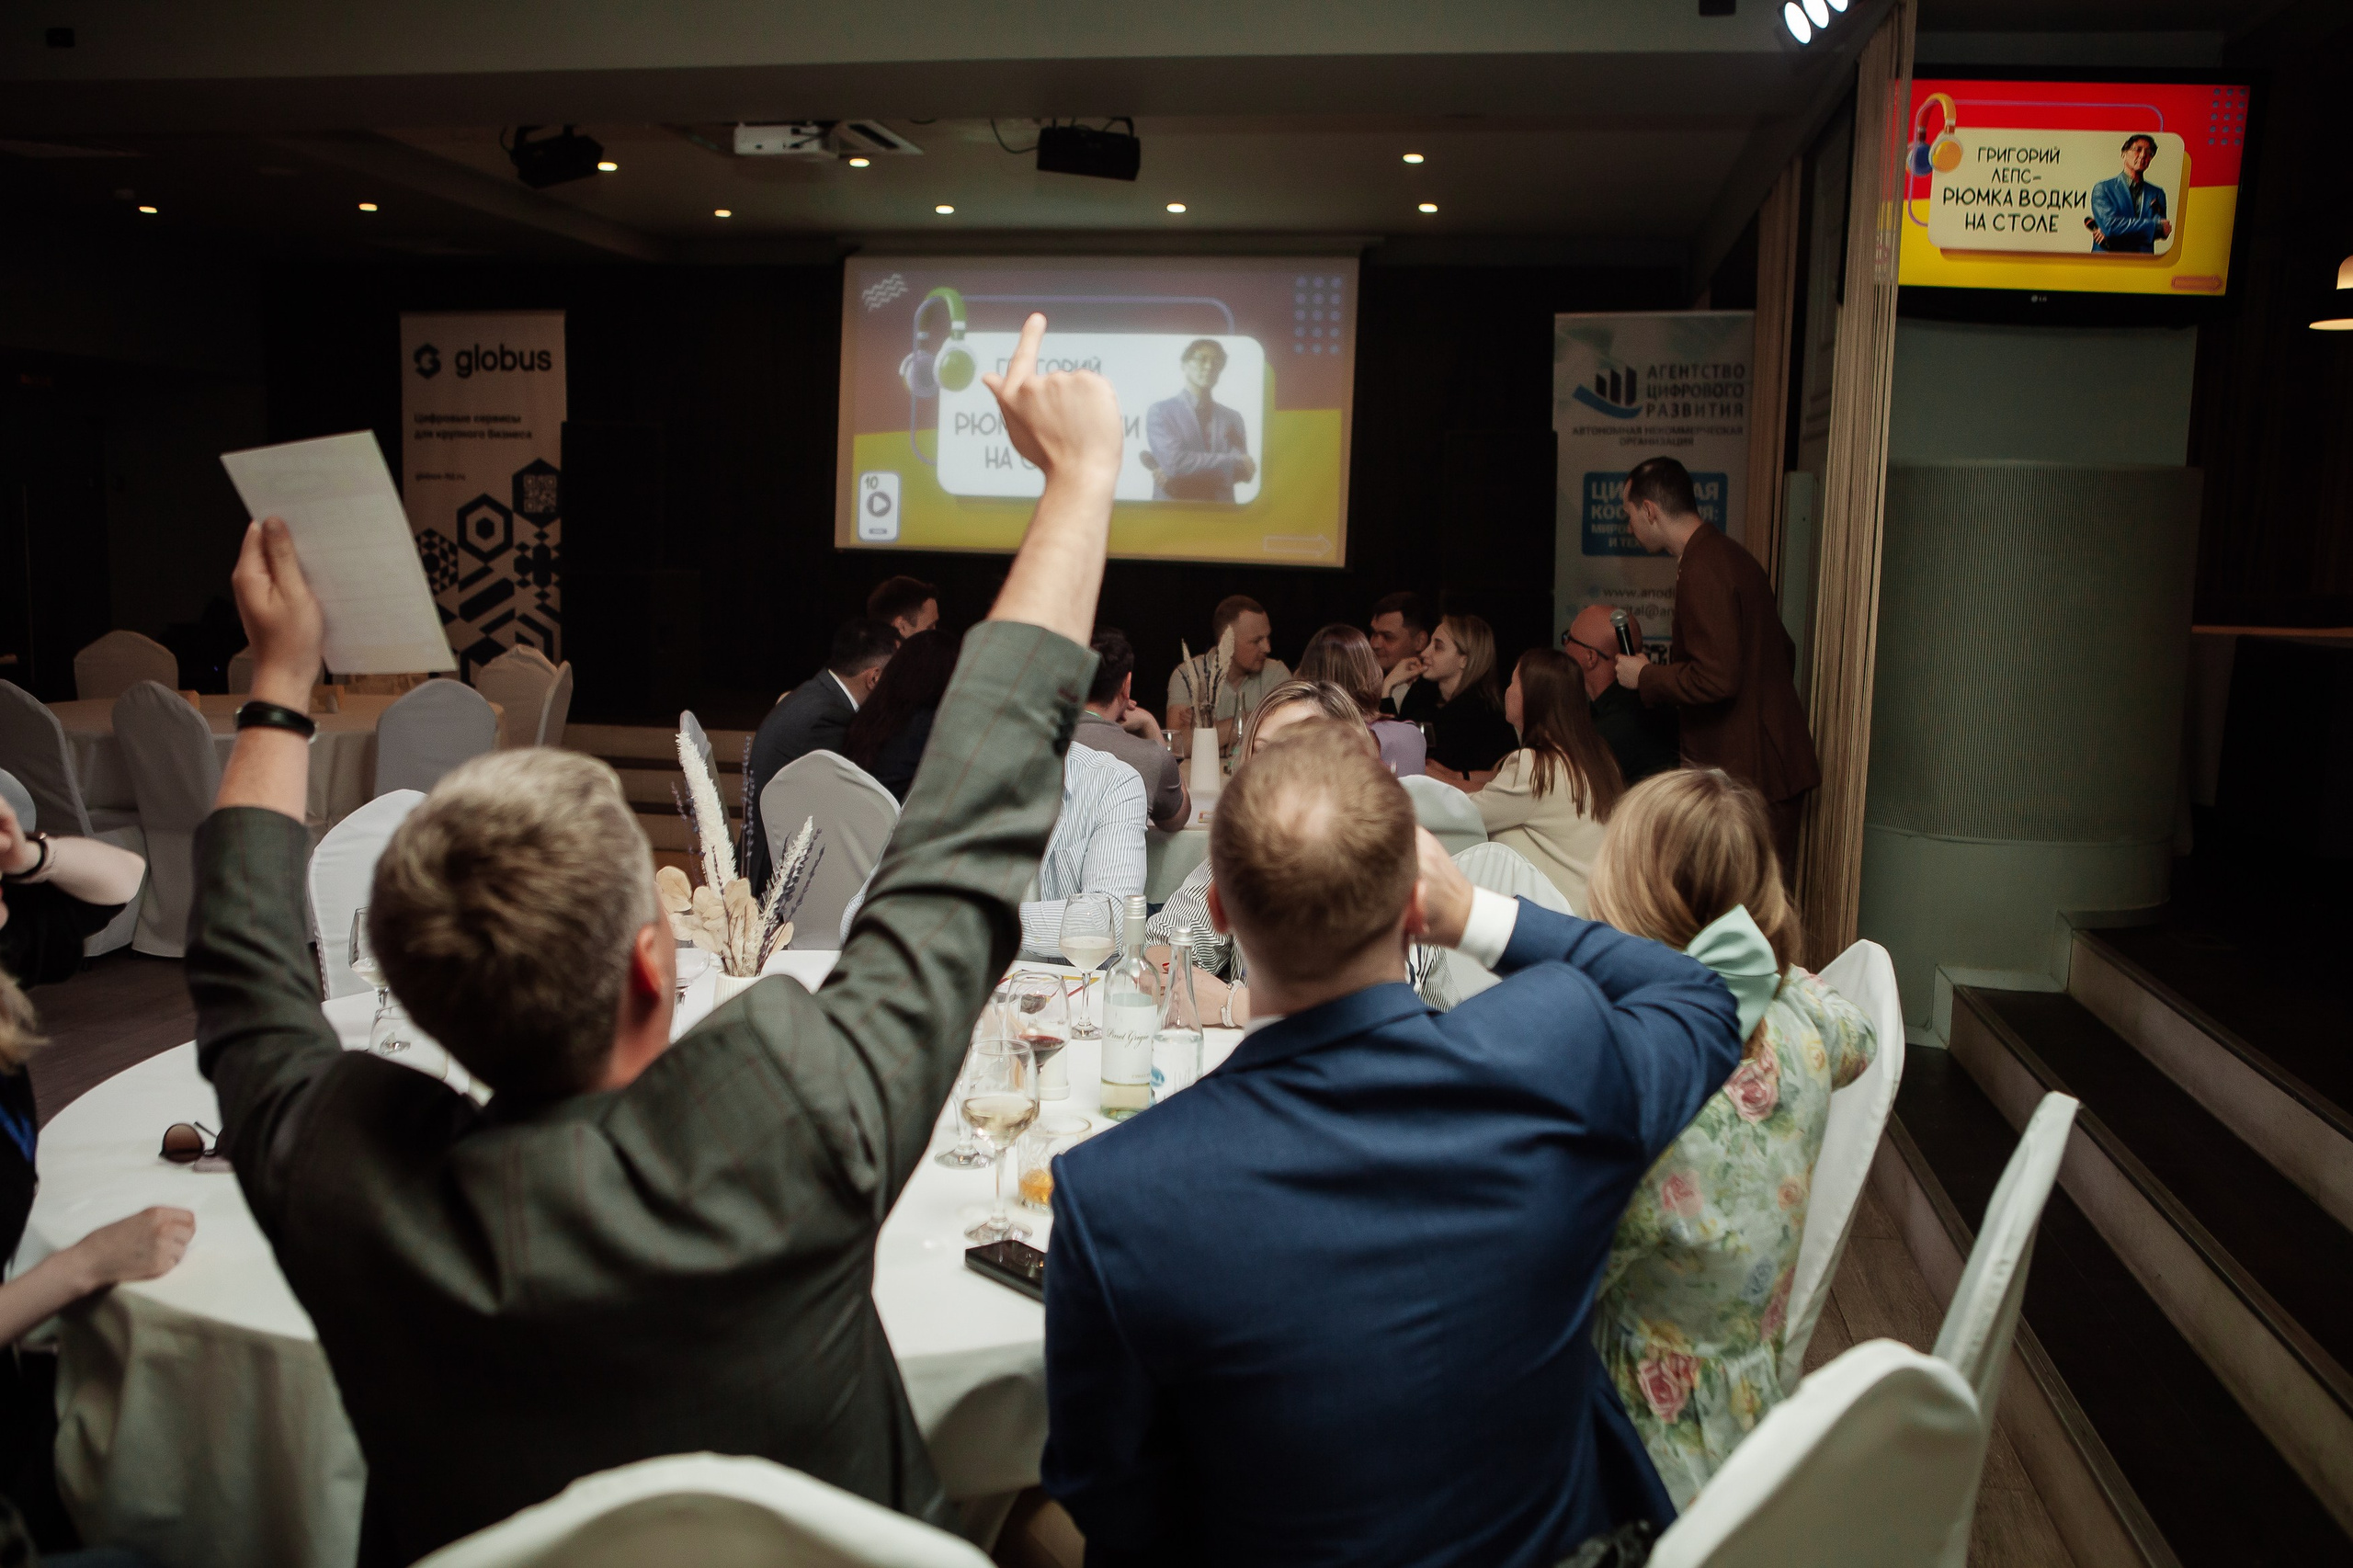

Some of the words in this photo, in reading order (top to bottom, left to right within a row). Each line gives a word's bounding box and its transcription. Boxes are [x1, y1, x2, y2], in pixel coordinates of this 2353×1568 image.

[1977, 145, 2061, 165] ГРИГОРИЙ
[1942, 187, 2013, 208] РЮМКА
[2018, 188, 2087, 210] ВОДКИ
[1964, 212, 1986, 232] НА
[1992, 213, 2060, 233] СТОЛЕ
[454, 343, 552, 379] globus
[1647, 364, 1745, 380] АГЕНТСТВО
[1646, 382, 1745, 399] ЦИФРОВОГО
[1646, 402, 1744, 418] РАЗВИТИЯ
[984, 446, 1013, 471] НА
[1106, 1028, 1127, 1040] Pinot
